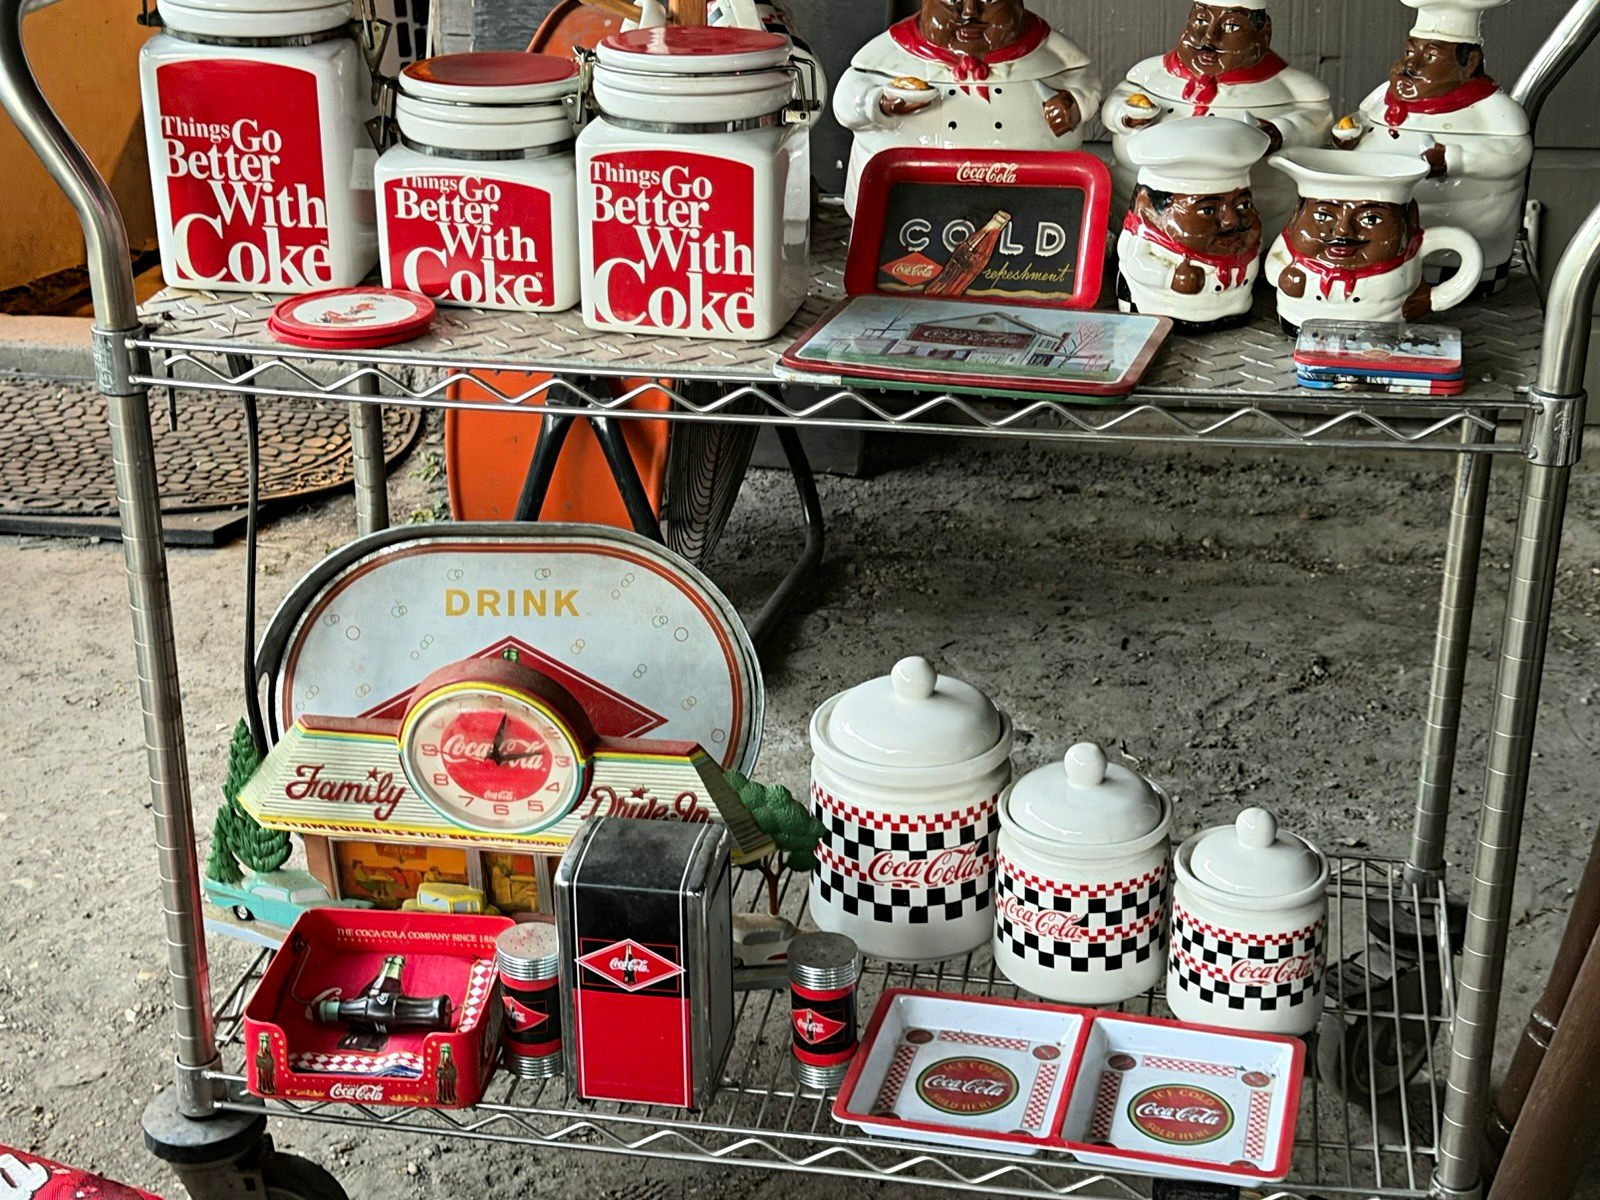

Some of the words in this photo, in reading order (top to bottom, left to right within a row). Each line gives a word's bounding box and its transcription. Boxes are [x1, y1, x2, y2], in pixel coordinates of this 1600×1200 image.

[161, 116, 231, 144] Things
[232, 118, 282, 154] Go
[166, 138, 281, 182] Better
[401, 176, 457, 193] Things
[458, 176, 502, 203] Go
[590, 161, 660, 189] Things
[662, 165, 713, 200] Go
[207, 179, 328, 229] With
[393, 188, 499, 225] Better
[591, 183, 710, 228] Better
[435, 221, 538, 262] With
[633, 225, 754, 276] With
[900, 218, 1066, 257] COLD
[982, 261, 1074, 289] refreshment
[445, 589, 580, 617] DRINK
[286, 763, 406, 821] Family
[868, 842, 983, 886] Coca-Cola
[407, 931, 450, 941] COMPANY
[451, 933, 478, 943] SINCE
[1005, 897, 1082, 938] Coca-Cola
